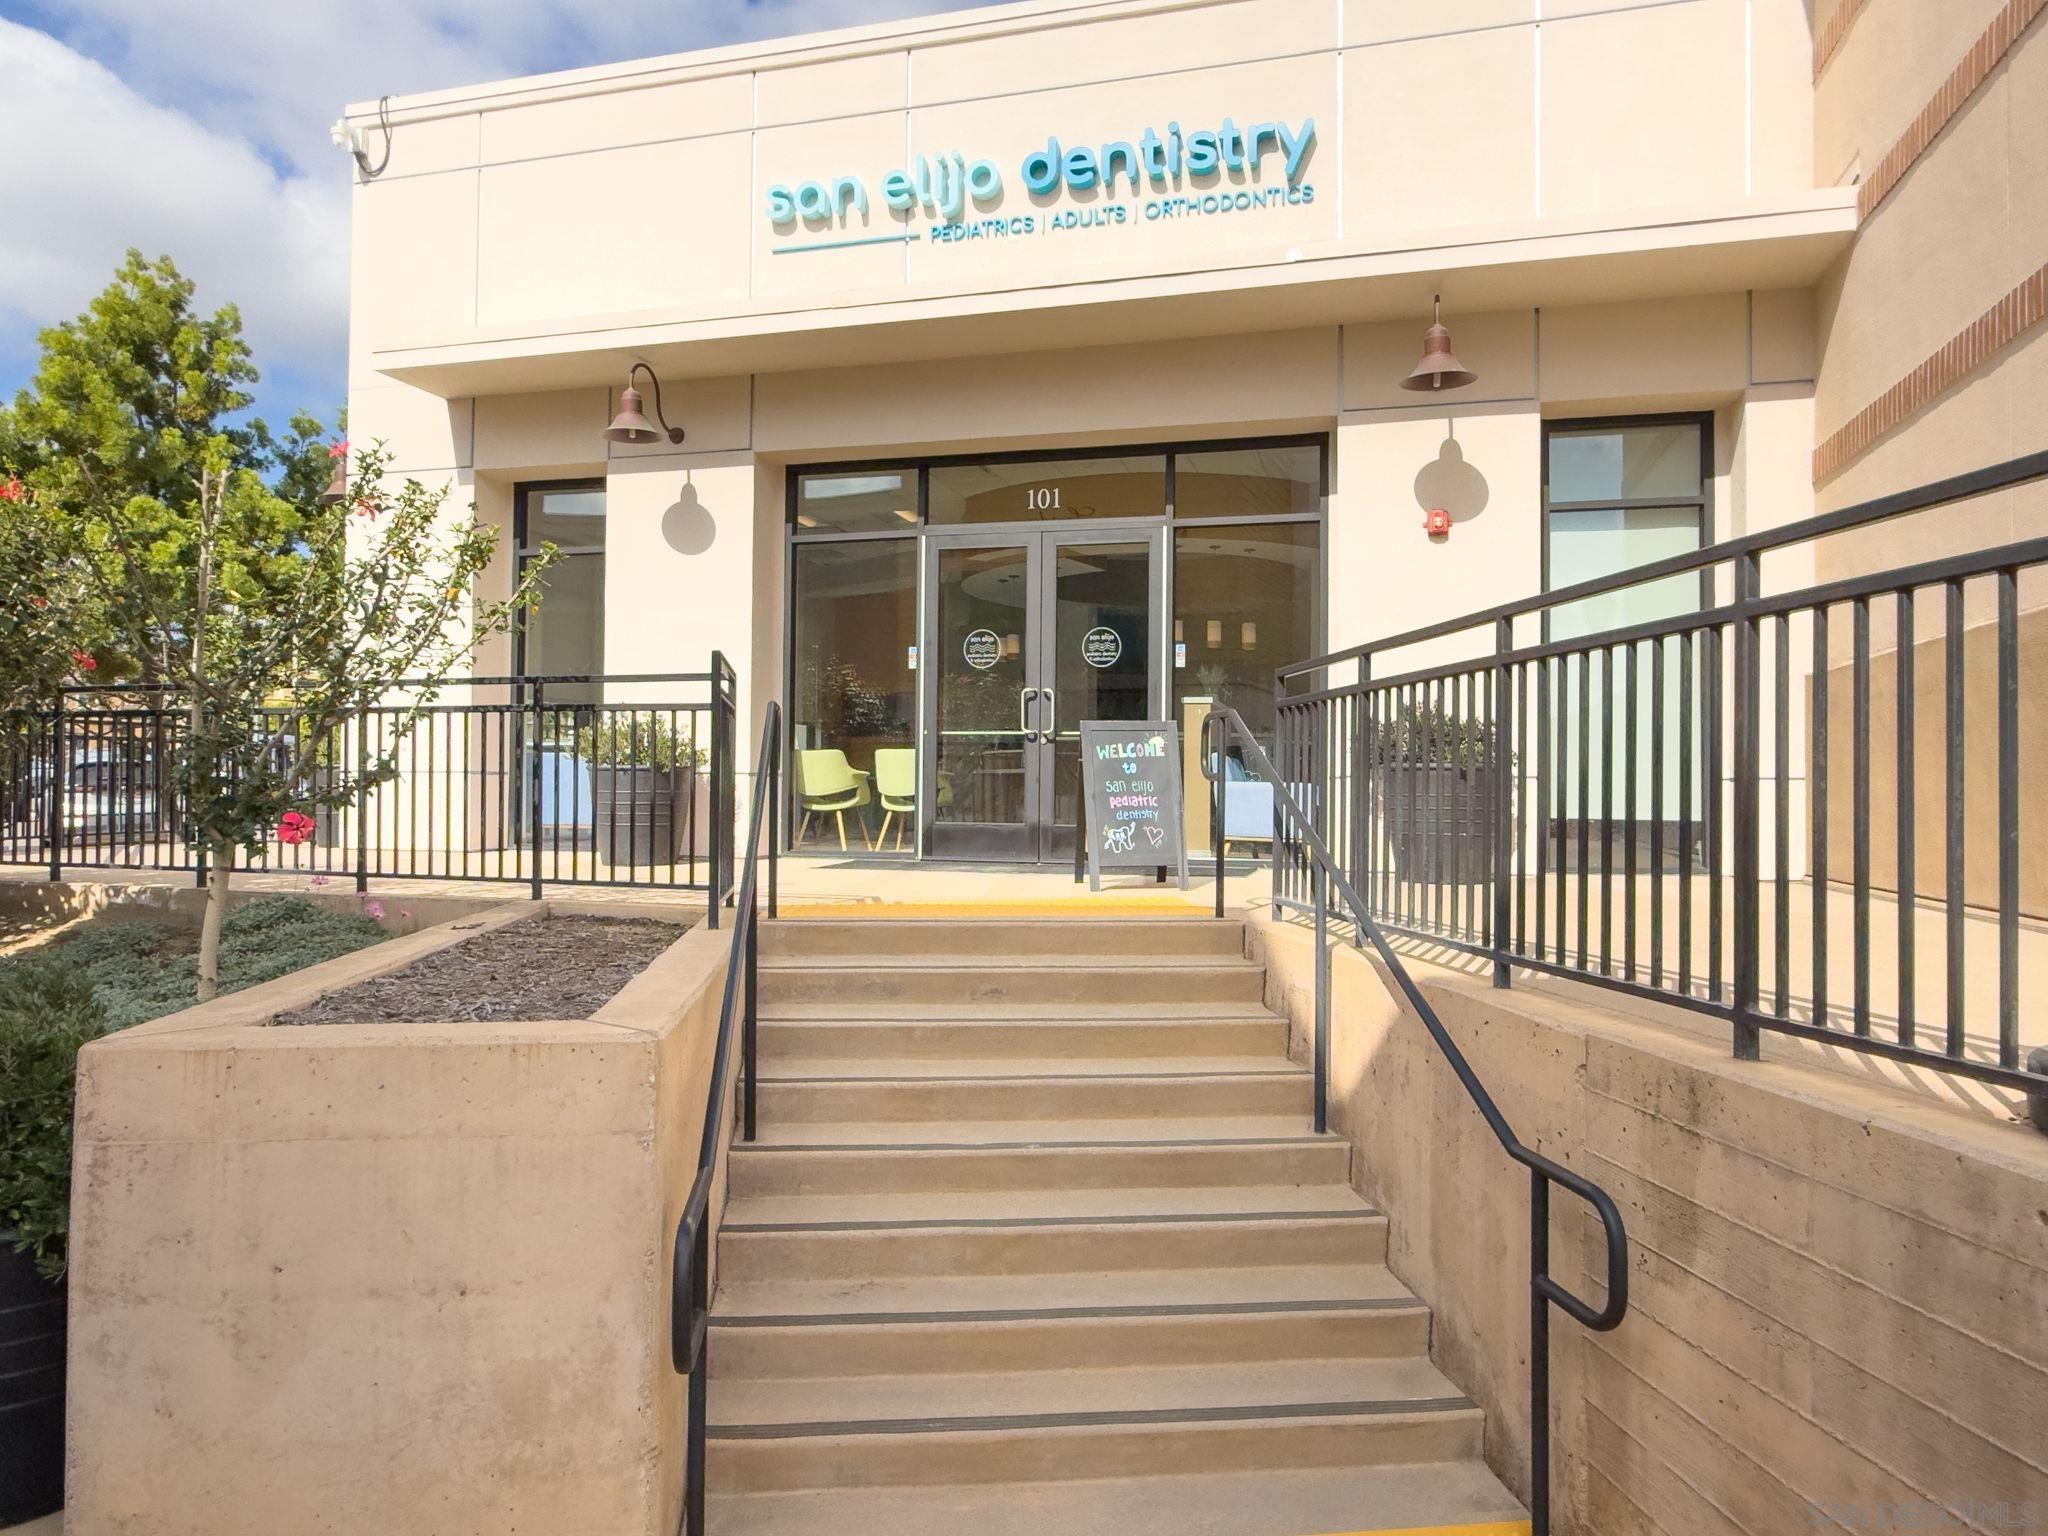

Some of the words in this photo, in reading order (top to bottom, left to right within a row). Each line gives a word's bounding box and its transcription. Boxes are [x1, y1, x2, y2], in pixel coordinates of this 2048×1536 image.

[765, 175, 868, 225] san
[881, 149, 1005, 221] elijo
[1021, 117, 1315, 196] dentistry
[930, 216, 1035, 243] PEDIATRICS
[1051, 204, 1127, 231] ADULTS
[1144, 183, 1315, 220] ORTHODONTICS
[1027, 488, 1061, 510] 101
[1096, 742, 1166, 760] WELCOME
[1122, 762, 1137, 774] to
[1105, 780, 1126, 792] san
[1109, 795, 1158, 808] pediatric
[1116, 809, 1159, 822] dentistry
